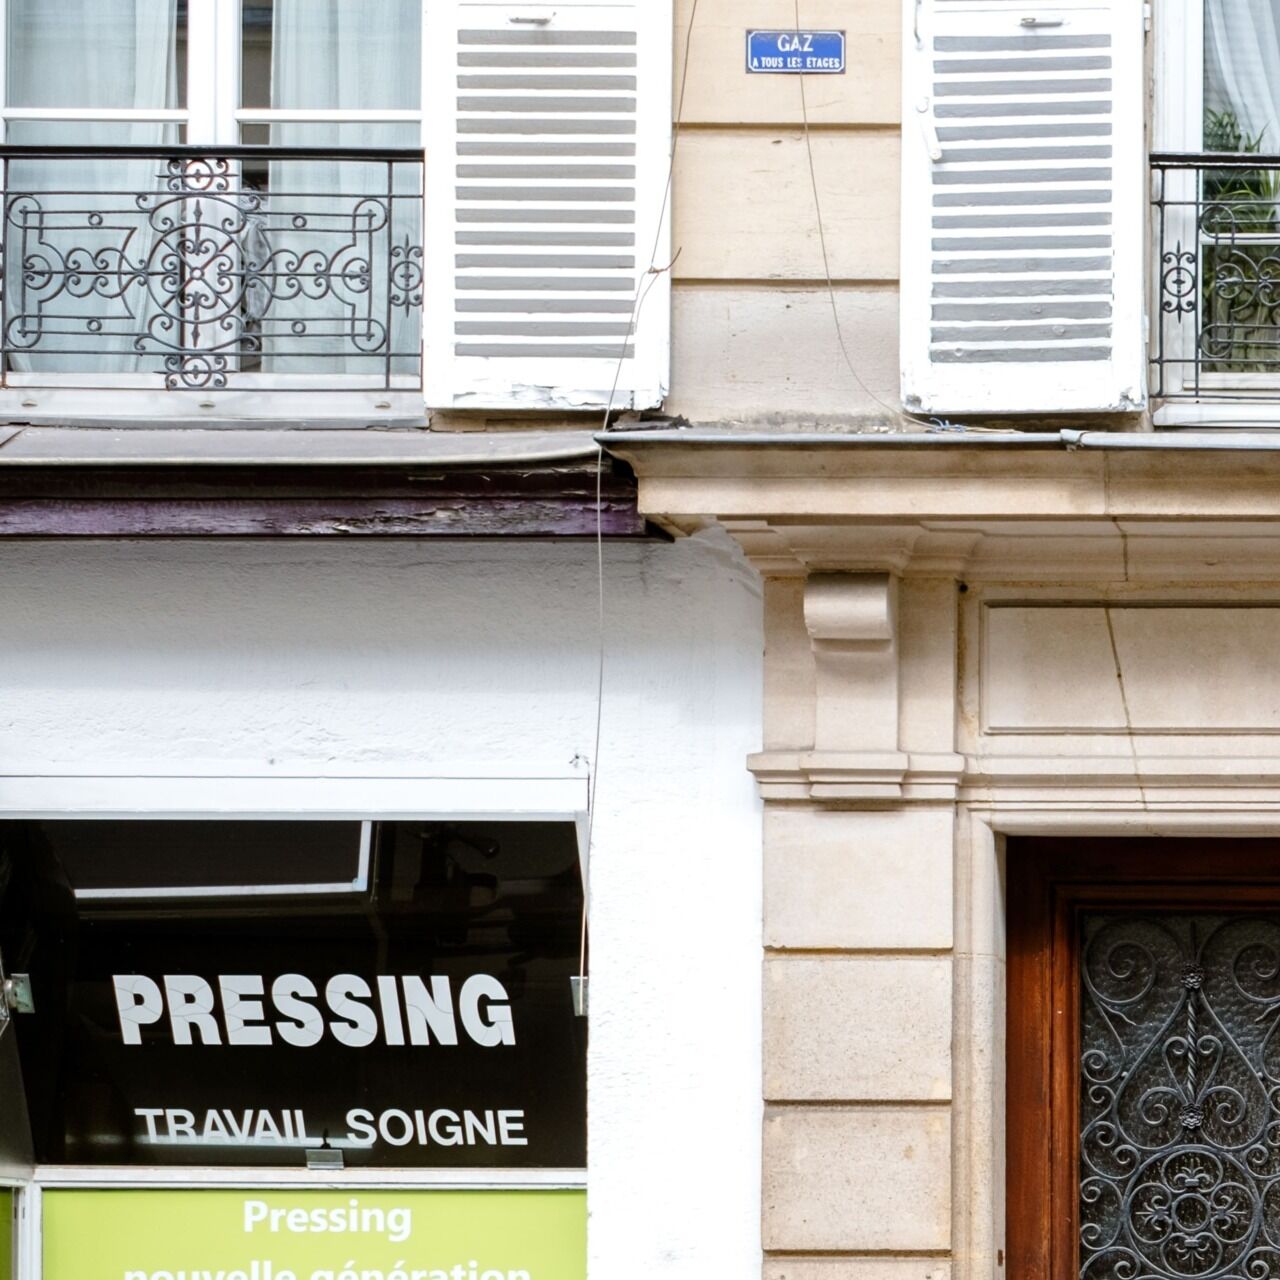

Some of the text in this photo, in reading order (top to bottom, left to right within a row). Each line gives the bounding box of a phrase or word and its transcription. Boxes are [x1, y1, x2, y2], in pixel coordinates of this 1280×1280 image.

[753, 57, 759, 68] A
[761, 57, 783, 68] TOUS
[787, 57, 802, 68] LES
[777, 34, 813, 52] GAZ
[112, 973, 517, 1048] PRESSING
[134, 1108, 529, 1147] TRAVAIL SOIGNE
[243, 1200, 412, 1241] Pressing
